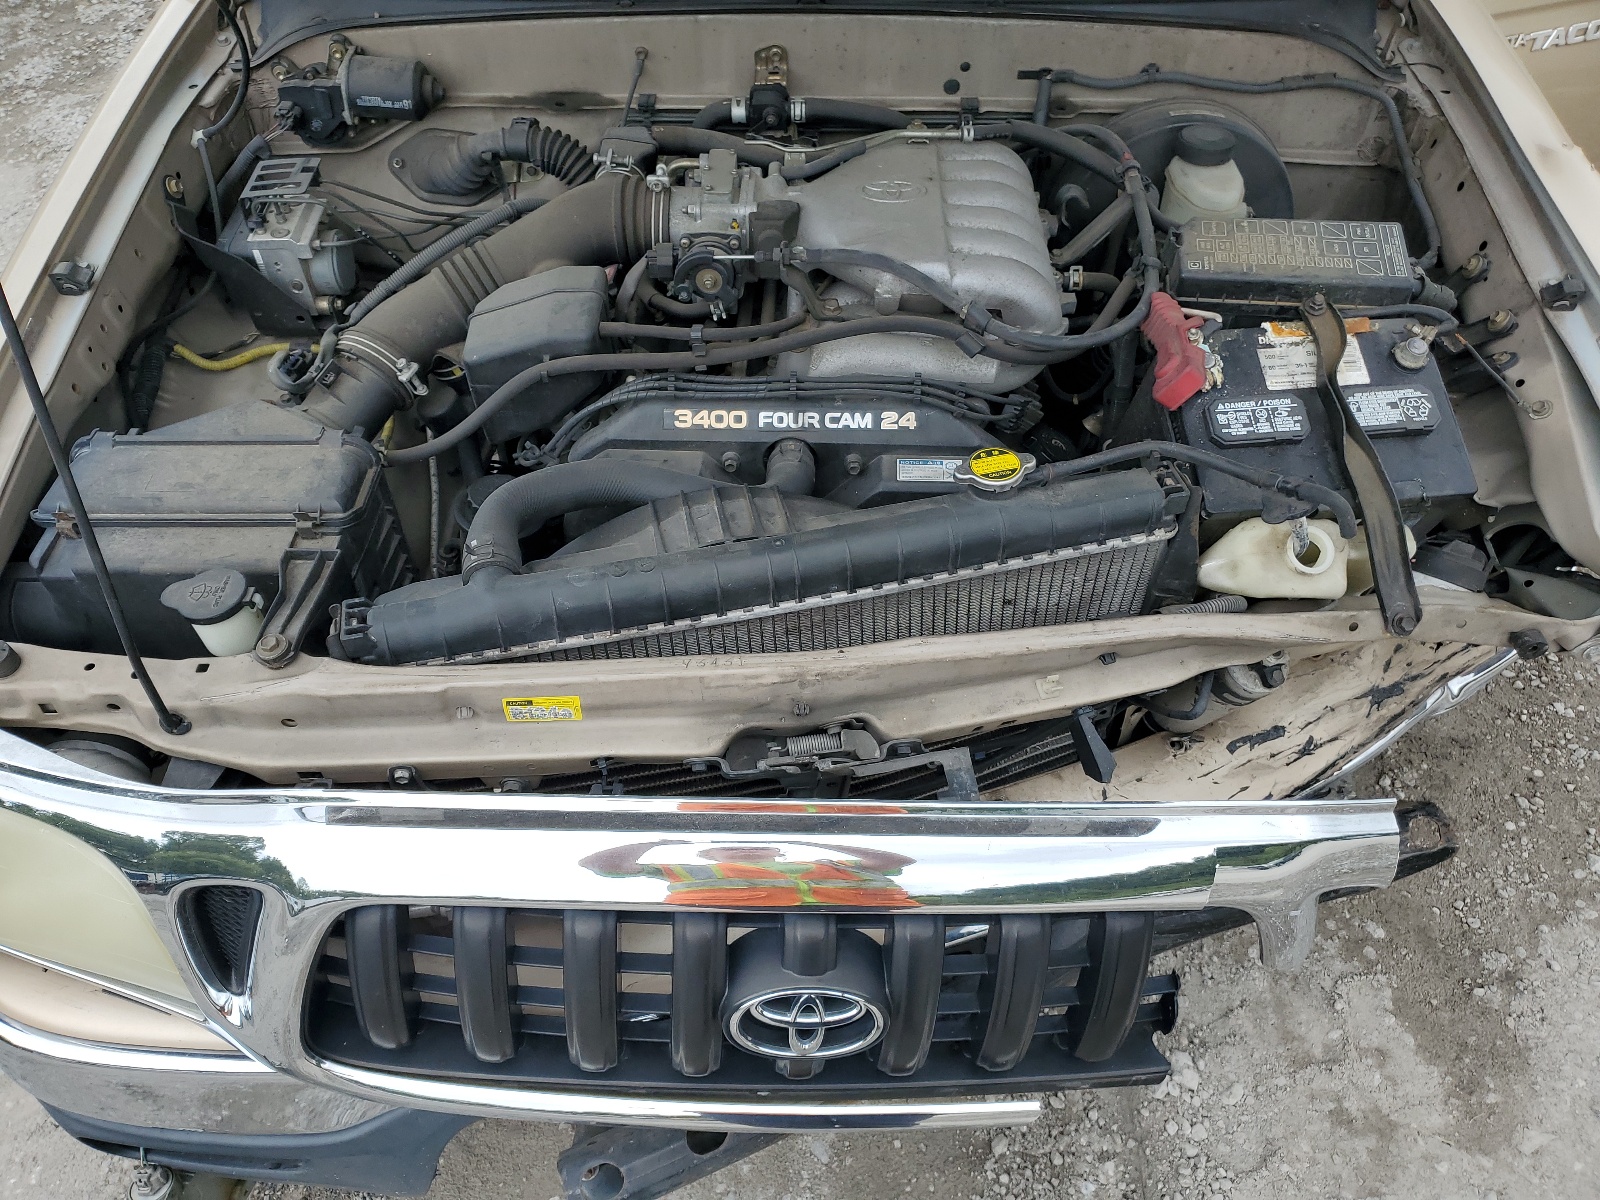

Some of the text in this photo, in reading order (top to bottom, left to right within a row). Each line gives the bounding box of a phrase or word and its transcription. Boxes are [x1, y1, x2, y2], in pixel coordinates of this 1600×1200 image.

[1225, 401, 1256, 409] DANGER
[1262, 398, 1291, 406] POISON
[673, 409, 917, 430] 3400 FOUR CAM 24
[988, 470, 1013, 478] CAUTION
